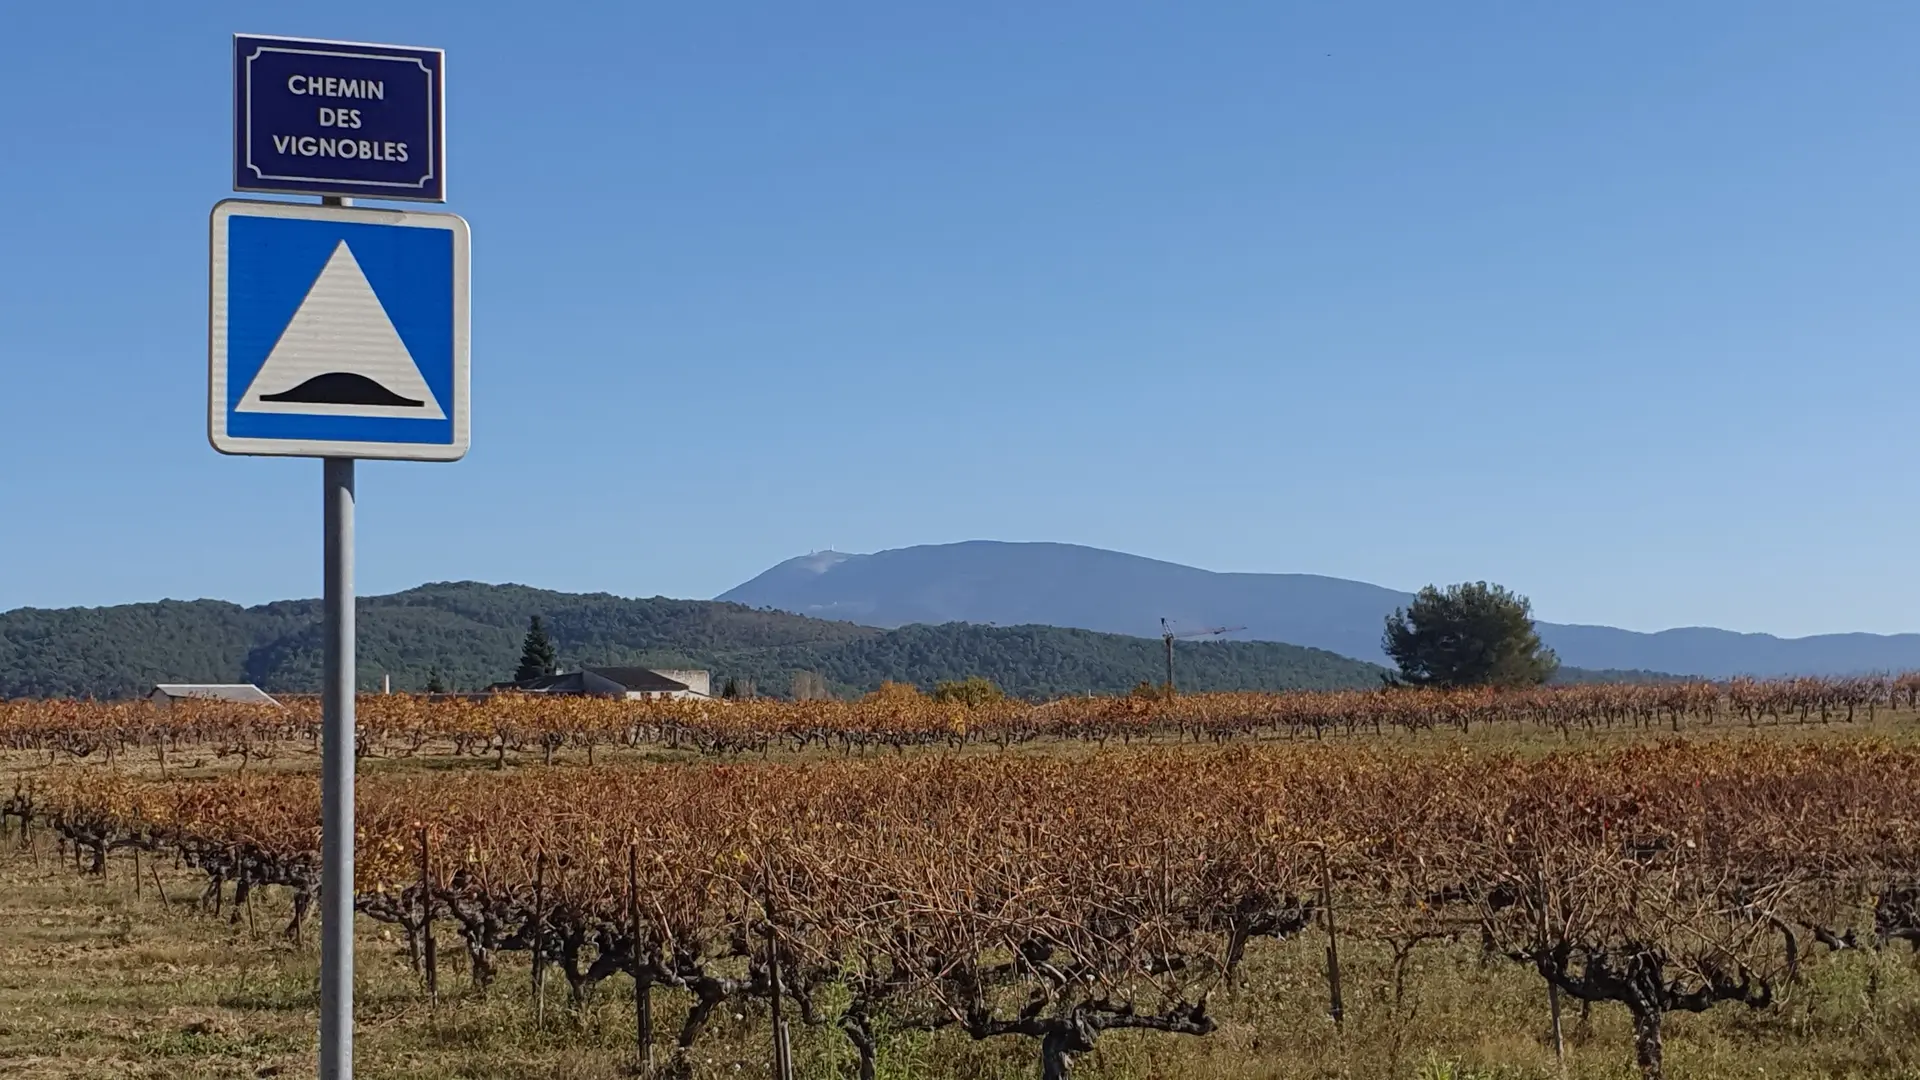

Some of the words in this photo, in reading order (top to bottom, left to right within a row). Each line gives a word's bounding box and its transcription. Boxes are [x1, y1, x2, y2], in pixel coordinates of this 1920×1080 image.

[288, 75, 384, 100] CHEMIN
[319, 108, 362, 129] DES
[272, 135, 409, 162] VIGNOBLES
